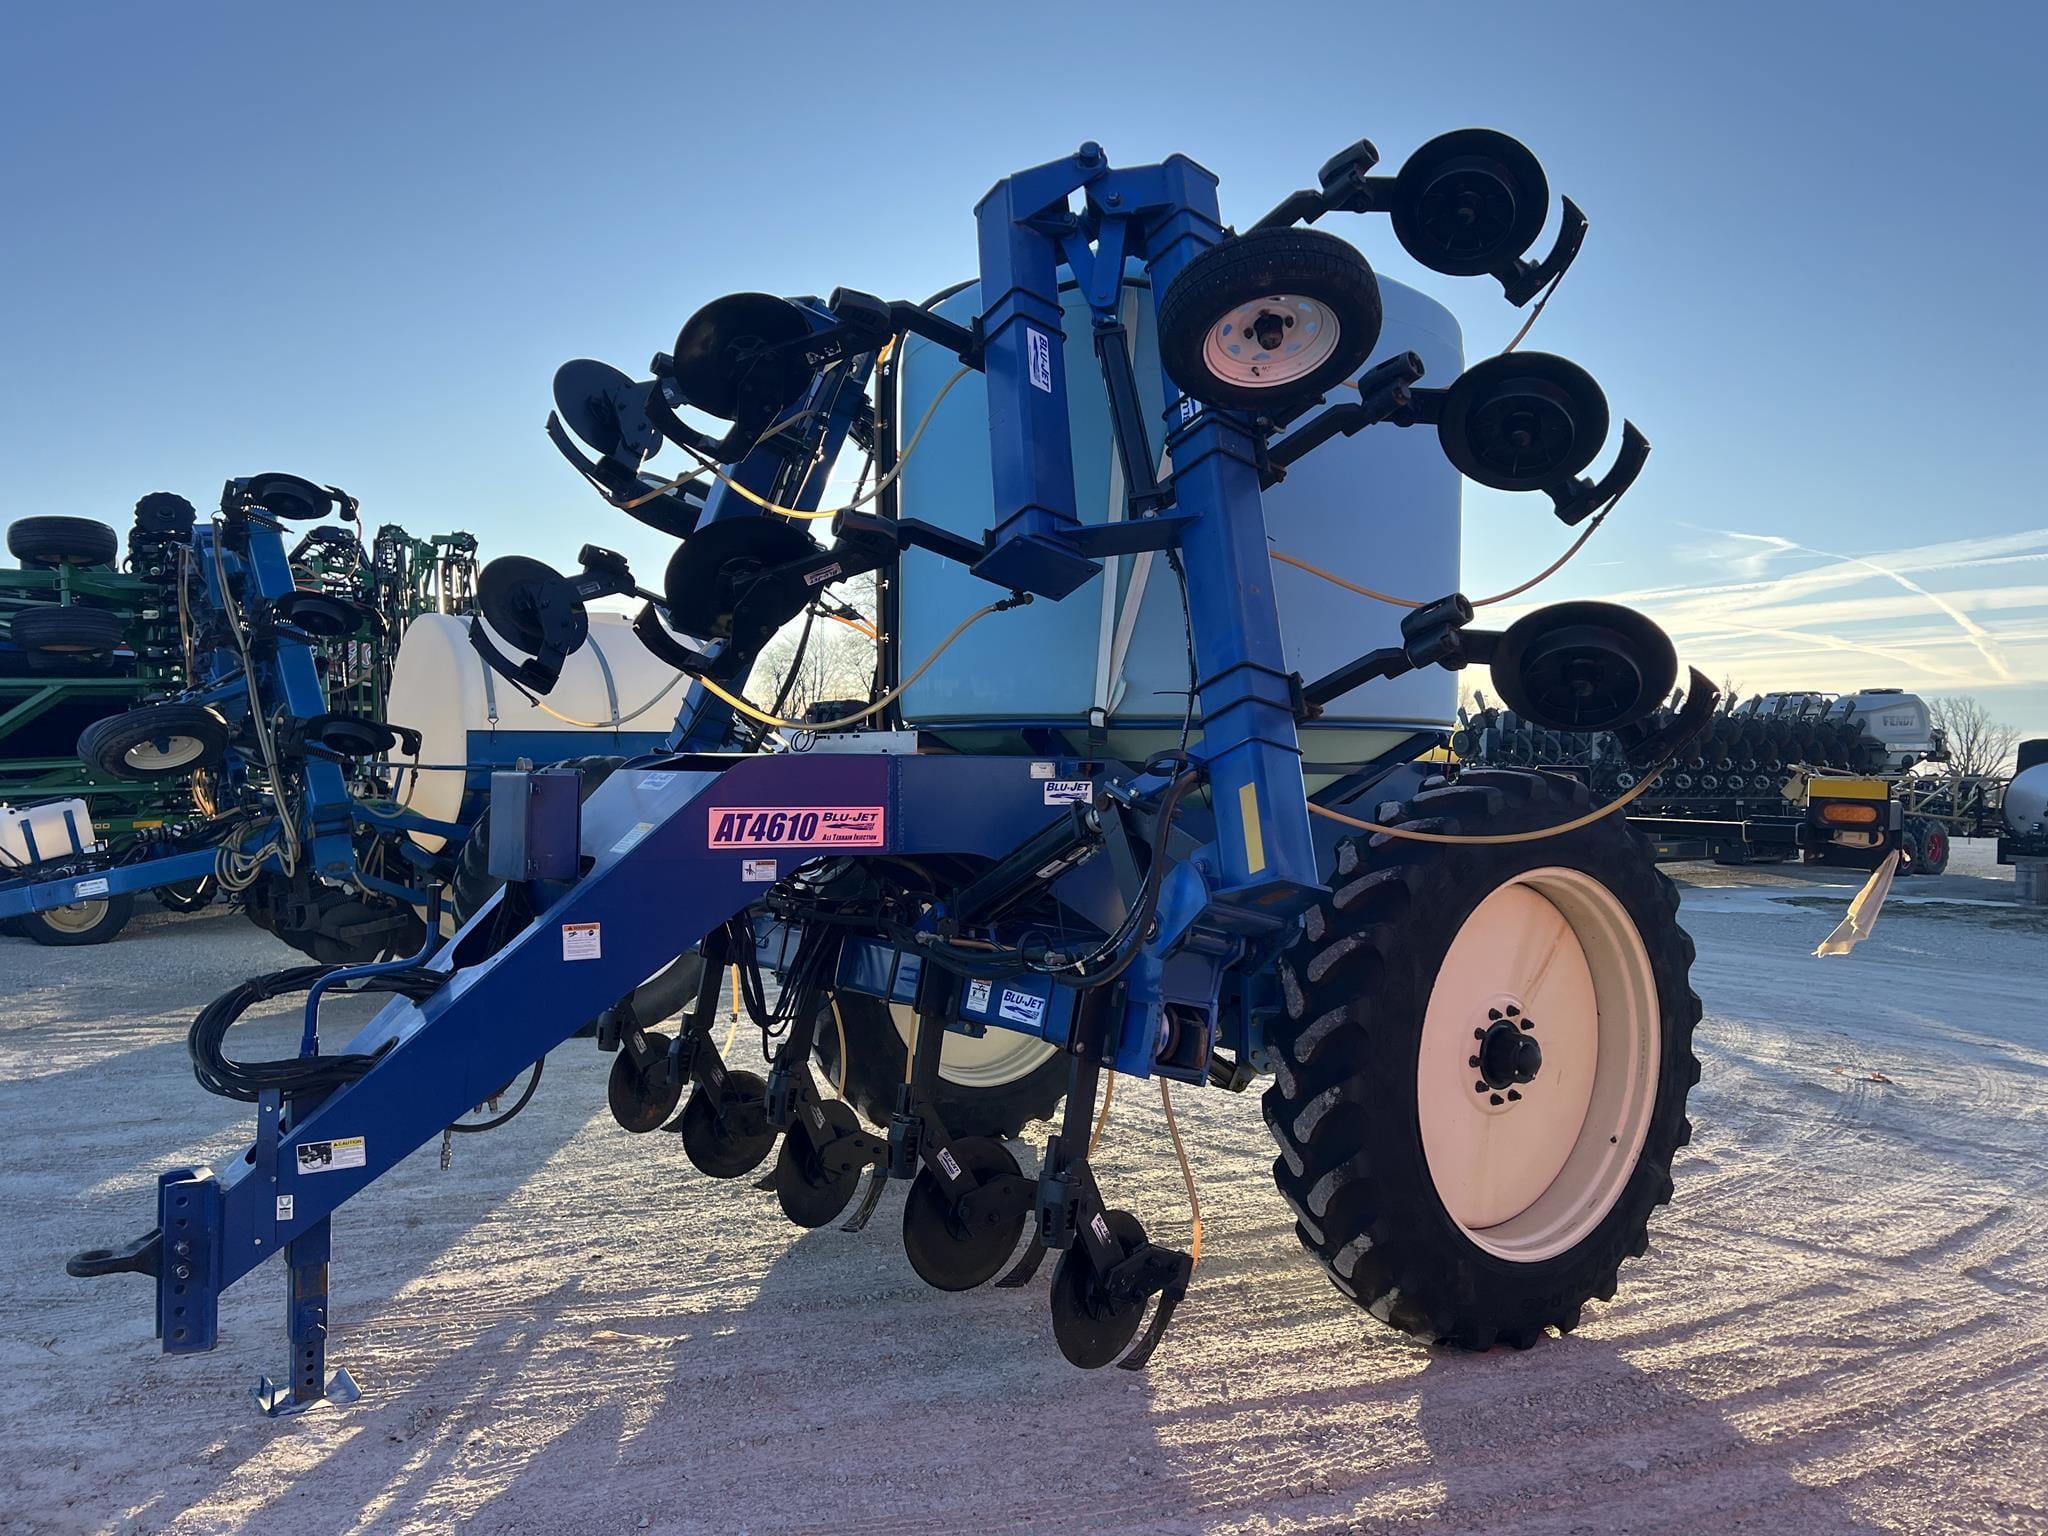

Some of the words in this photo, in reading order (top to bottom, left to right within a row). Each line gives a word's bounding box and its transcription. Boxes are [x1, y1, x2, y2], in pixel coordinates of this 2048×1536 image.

[1039, 335, 1050, 391] BLU-JET
[1882, 715, 1915, 727] FENDT
[1046, 782, 1090, 791] BLU-JET
[822, 812, 878, 822] BLU-JET
[713, 811, 819, 842] AT4610
[1003, 990, 1045, 1010] BLU-JET
